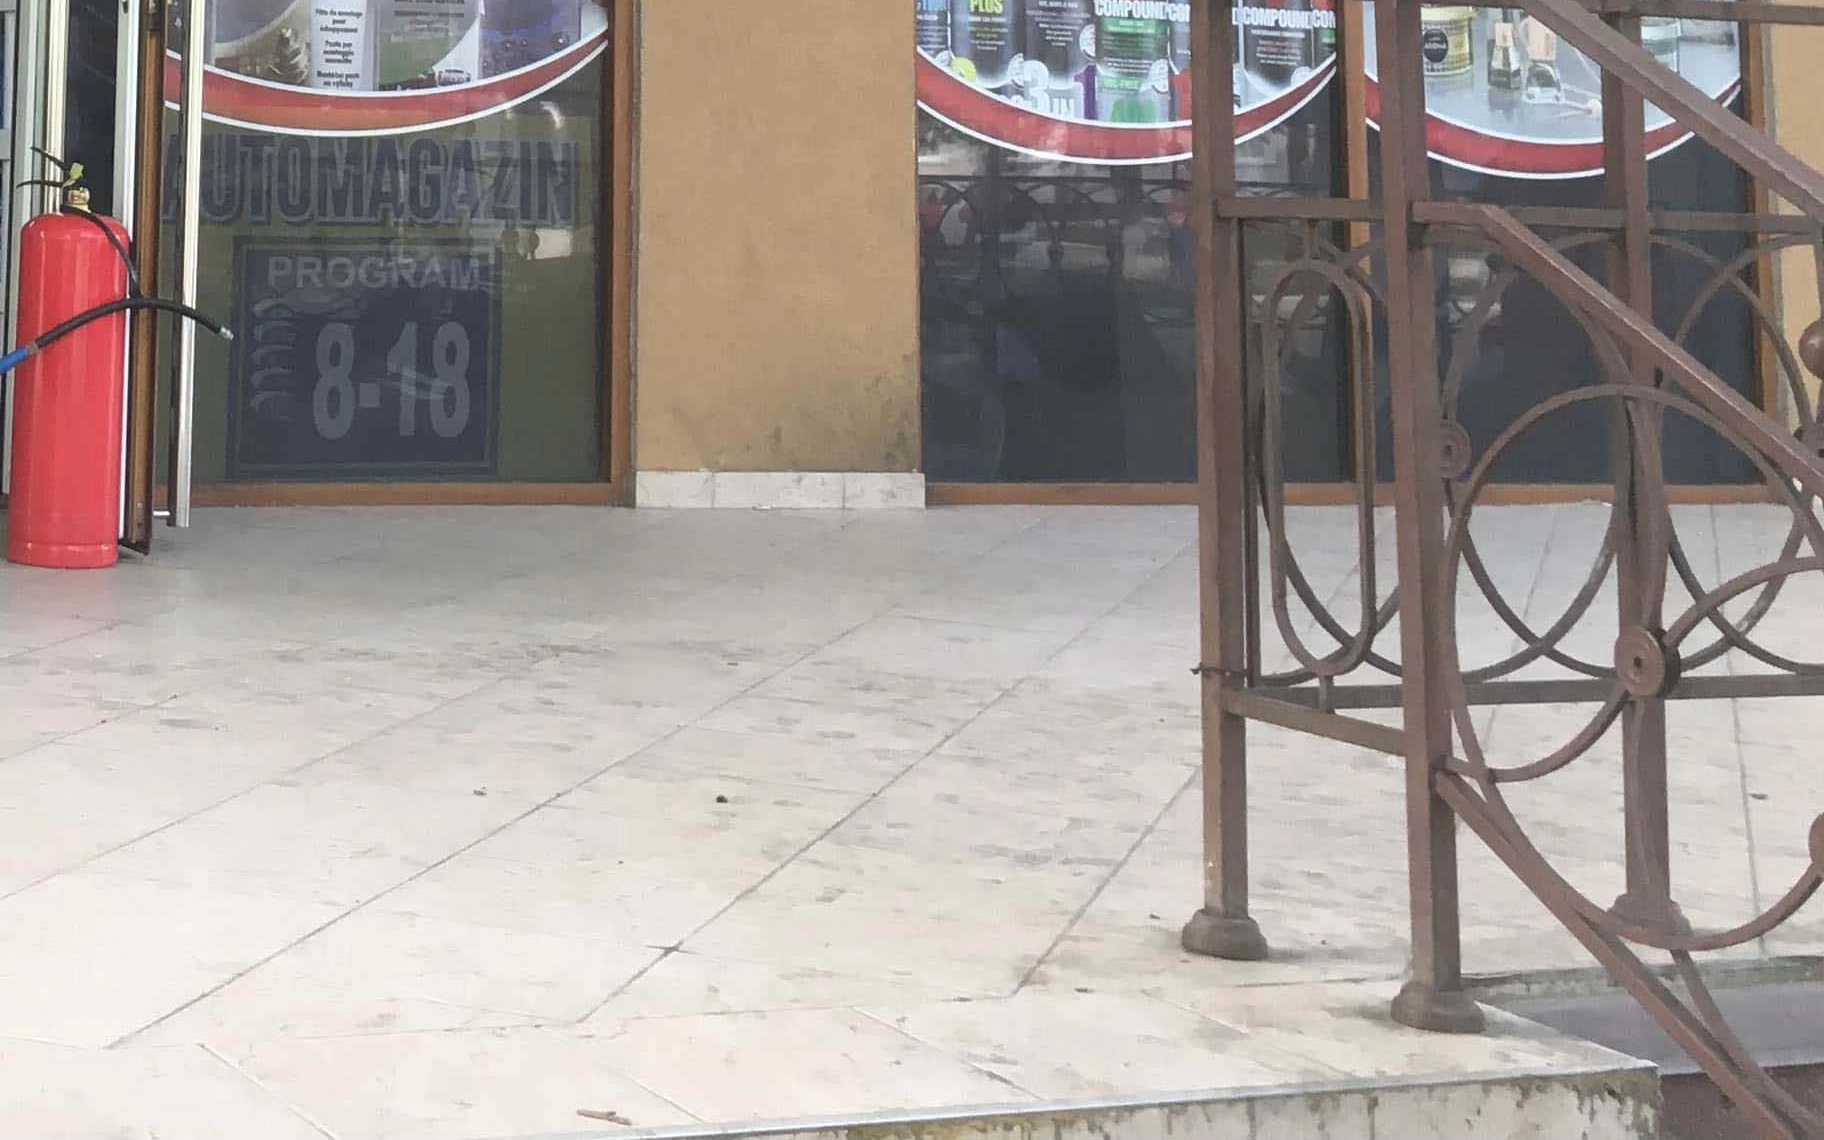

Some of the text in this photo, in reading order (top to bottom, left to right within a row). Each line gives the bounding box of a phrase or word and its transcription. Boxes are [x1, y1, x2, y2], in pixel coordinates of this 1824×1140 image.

[1244, 6, 1312, 29] COMPOUND
[267, 256, 480, 290] PROGRAM
[312, 321, 472, 440] 8-18
